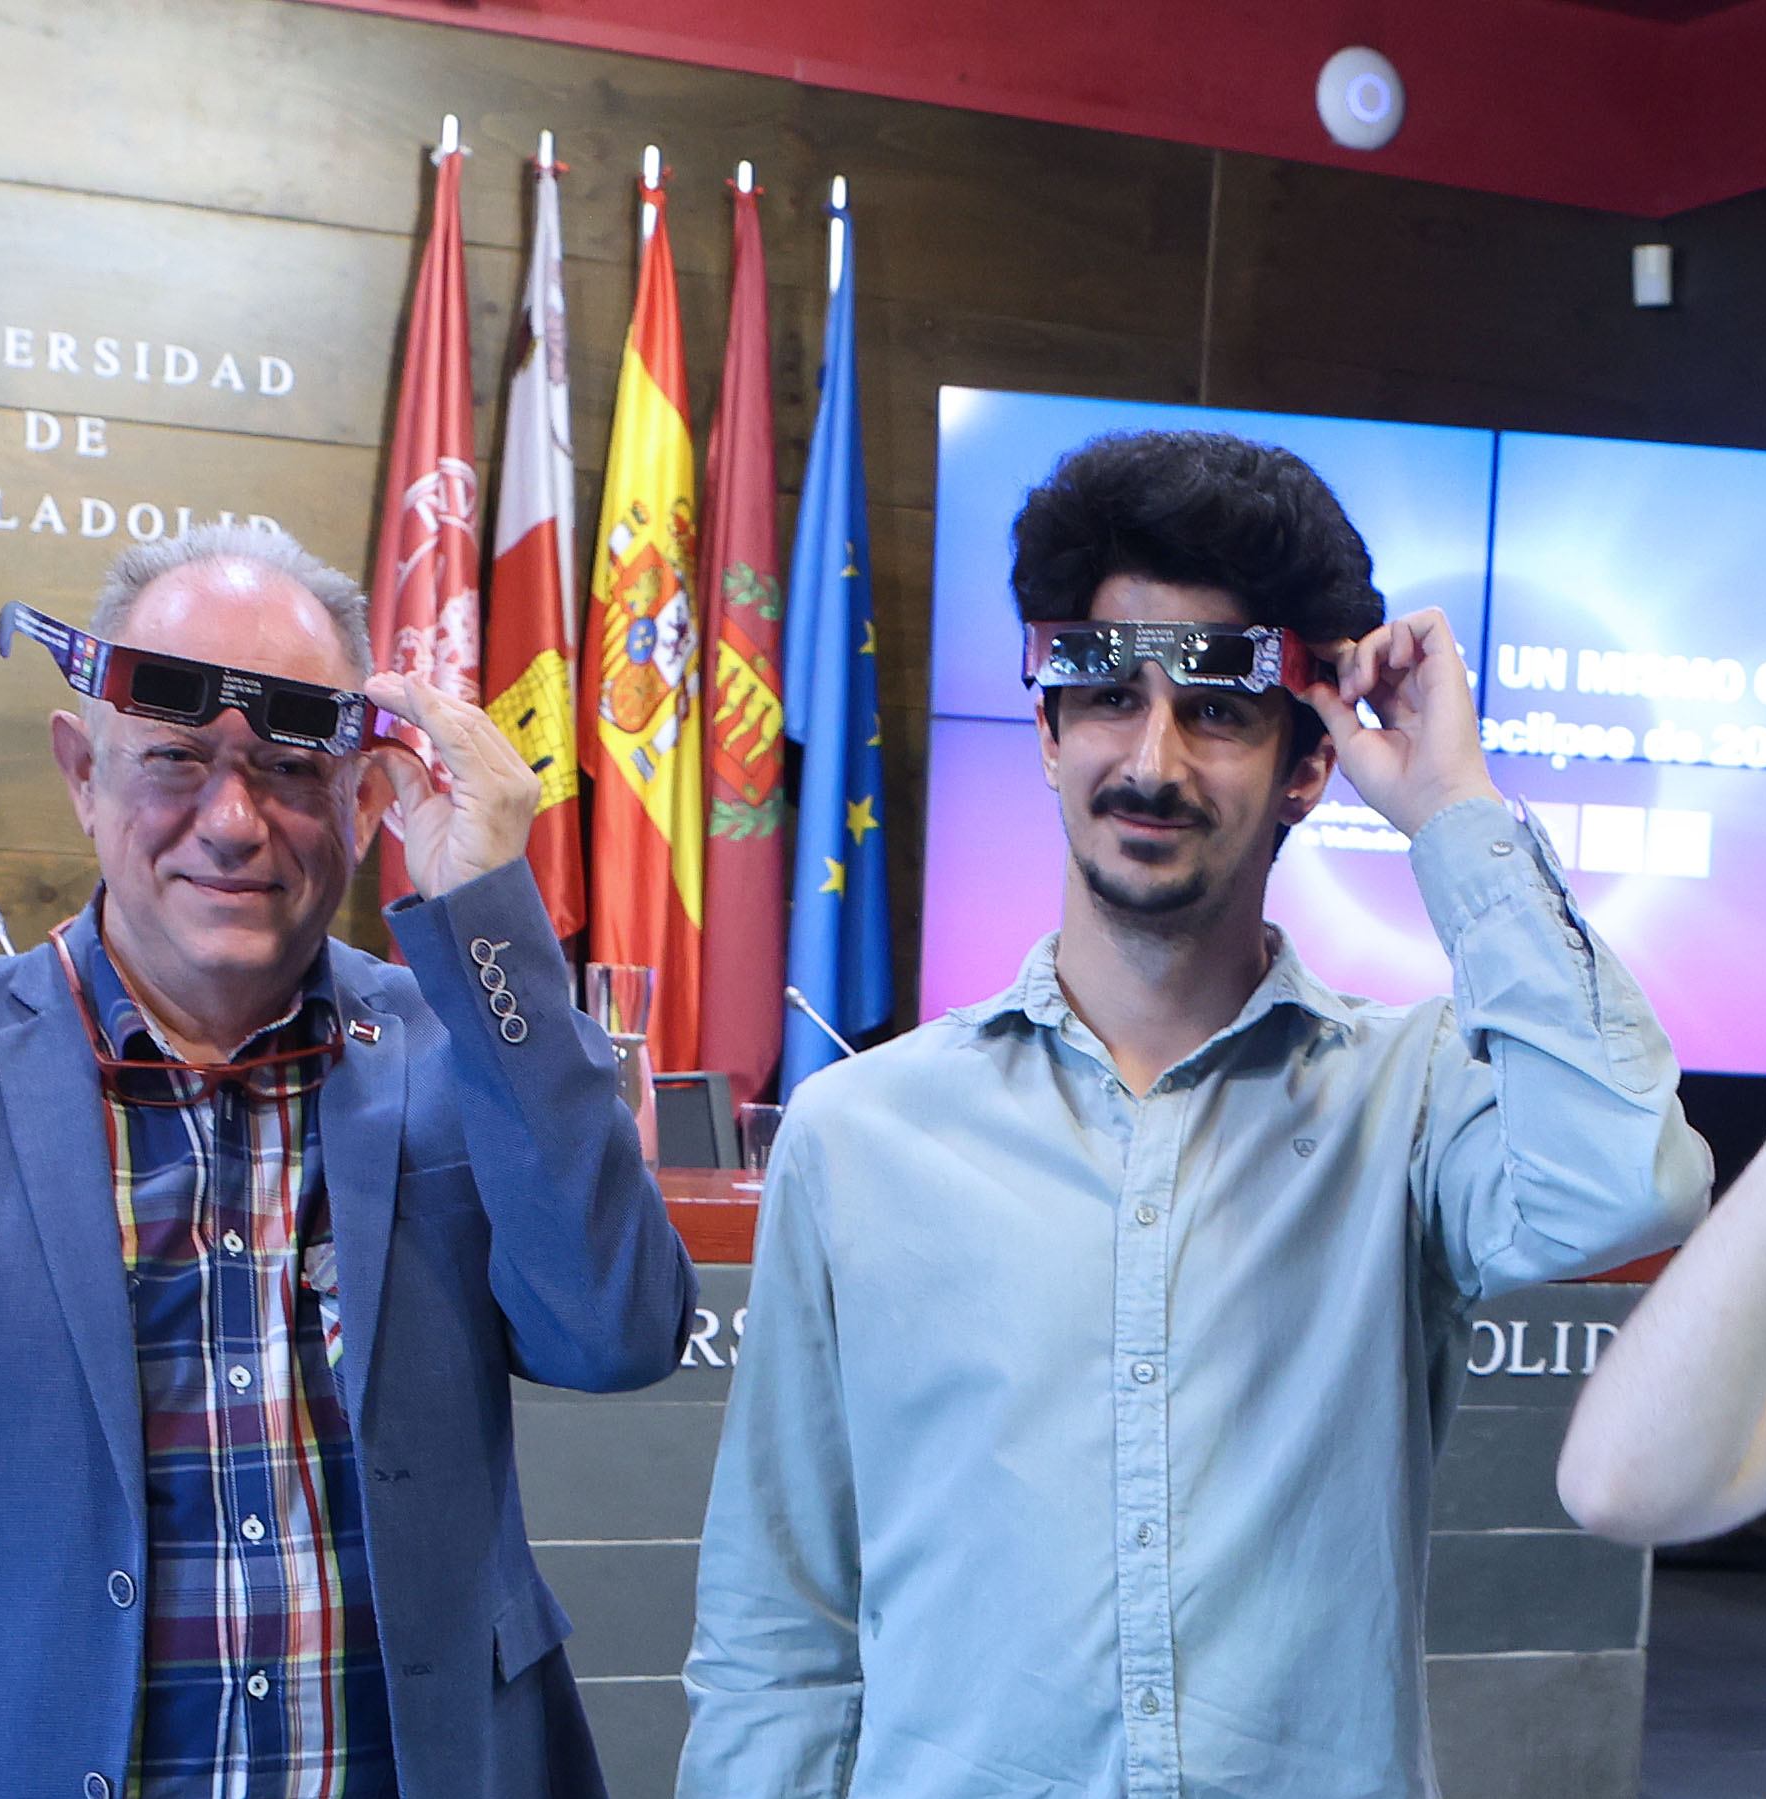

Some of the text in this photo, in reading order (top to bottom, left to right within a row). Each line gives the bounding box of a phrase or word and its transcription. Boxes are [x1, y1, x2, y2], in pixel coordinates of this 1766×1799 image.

[24, 409, 108, 458] DE
[1497, 644, 1567, 691] UN
[1643, 720, 1703, 763] de
